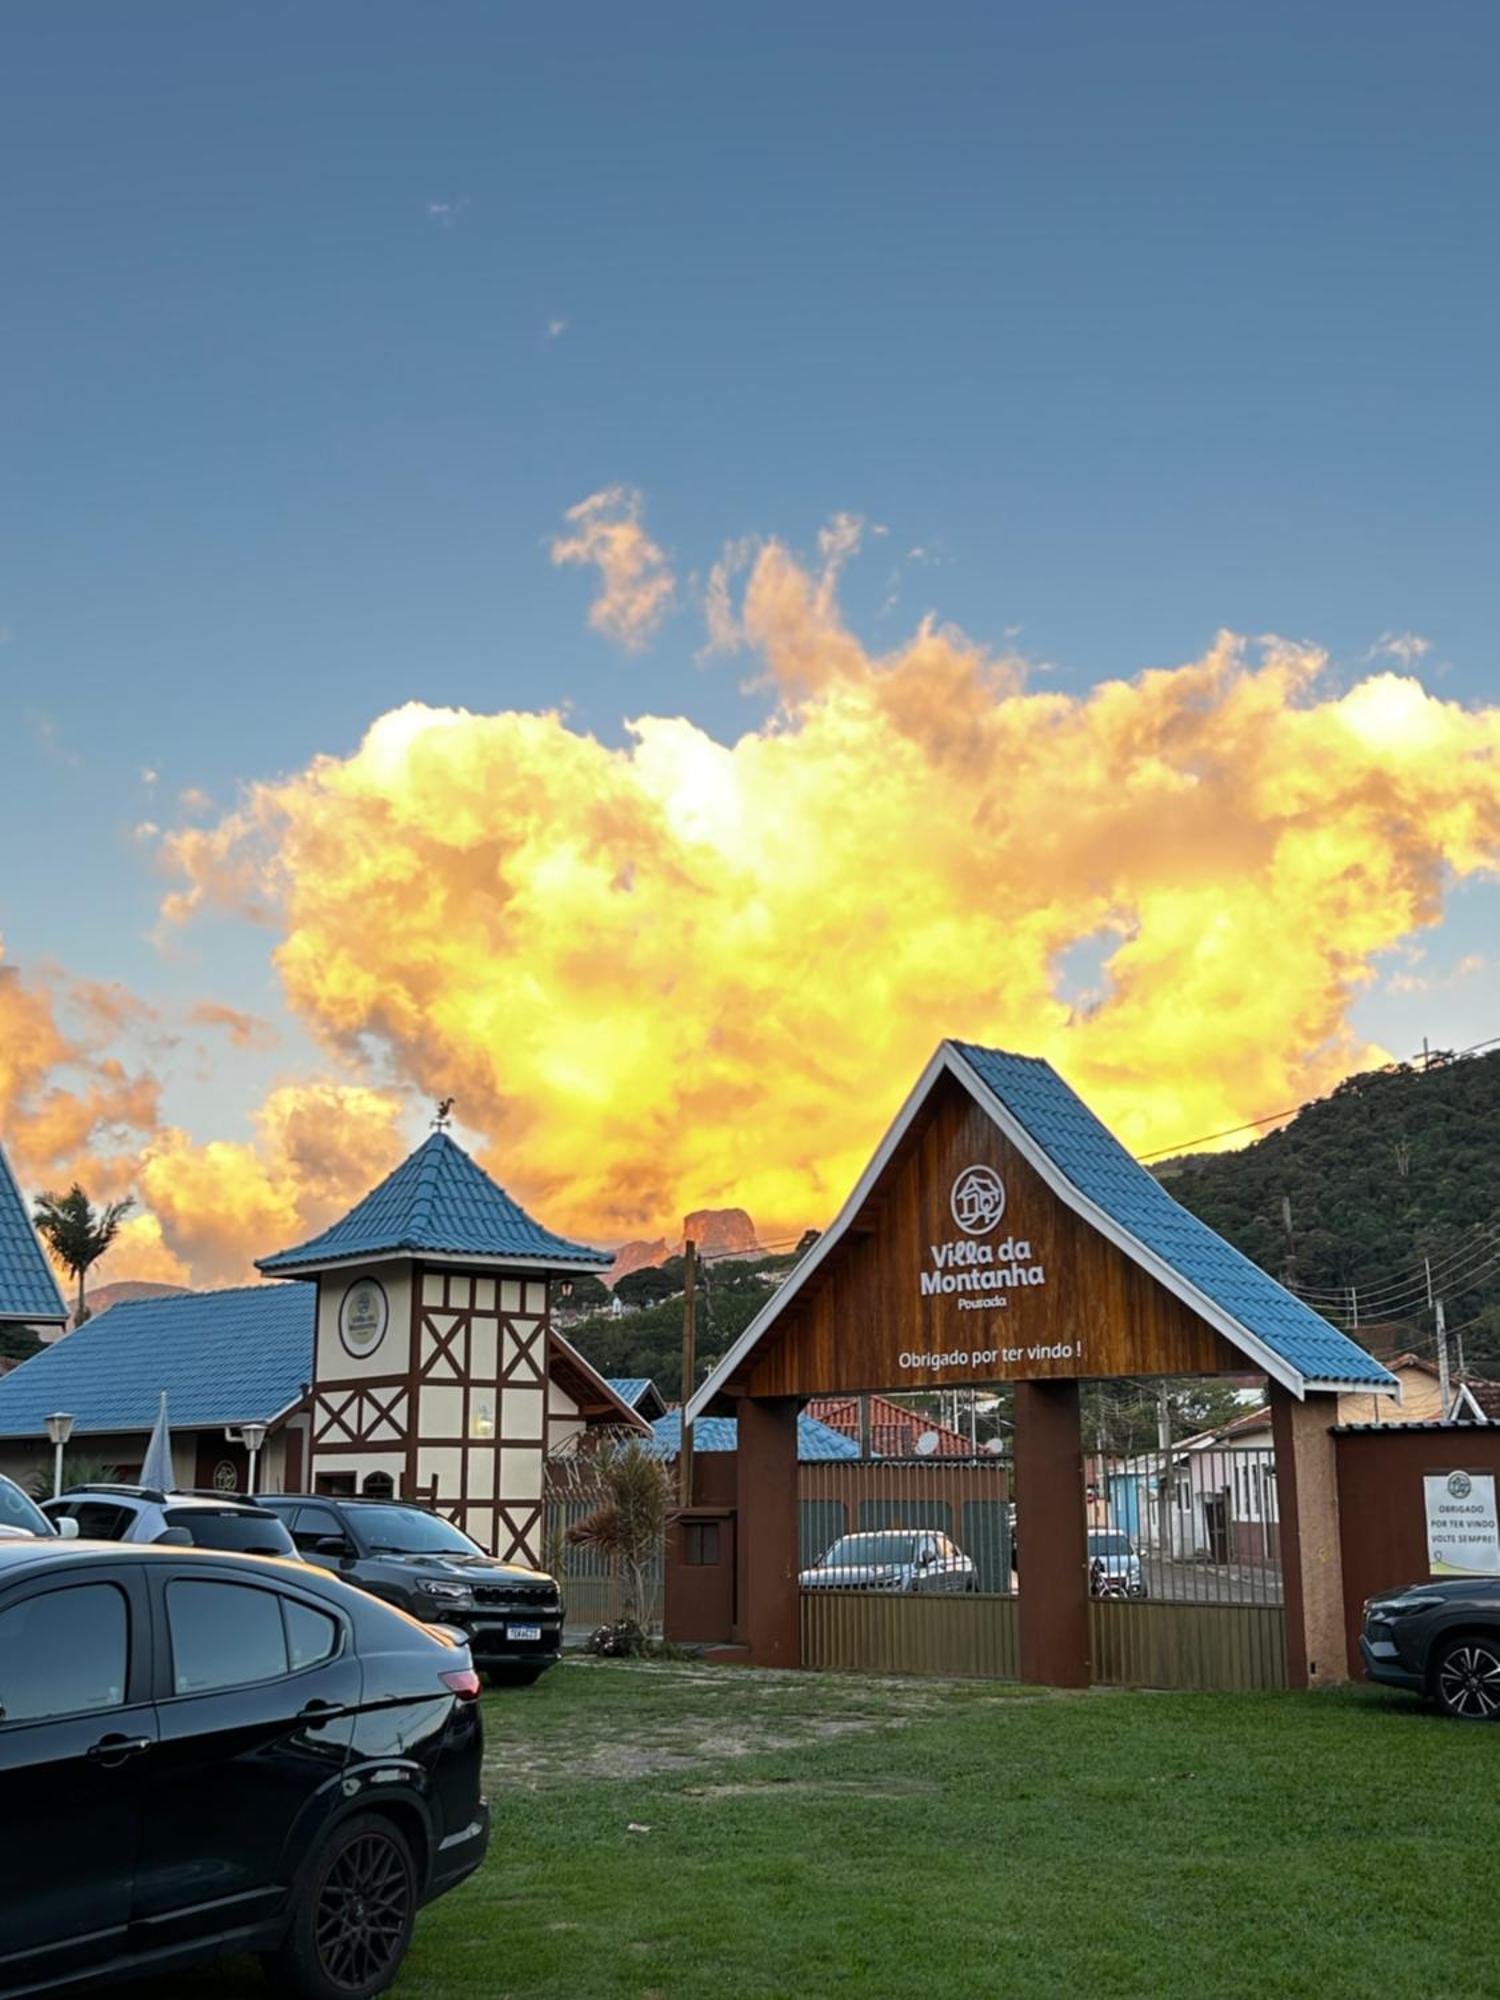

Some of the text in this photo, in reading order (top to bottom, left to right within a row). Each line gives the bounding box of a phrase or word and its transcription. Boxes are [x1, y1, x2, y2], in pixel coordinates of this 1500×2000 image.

[931, 1238, 1031, 1268] Villa da
[920, 1264, 1045, 1295] Montanha
[958, 1295, 1007, 1310] Pousada
[899, 1351, 968, 1371] Obrigado
[972, 1350, 996, 1368] por
[1002, 1347, 1023, 1361] ter
[1027, 1343, 1072, 1360] vindo
[1438, 1505, 1484, 1513] OBRIGADO
[1431, 1520, 1495, 1528] POR TER VINDO
[1432, 1535, 1456, 1543] VOLTE
